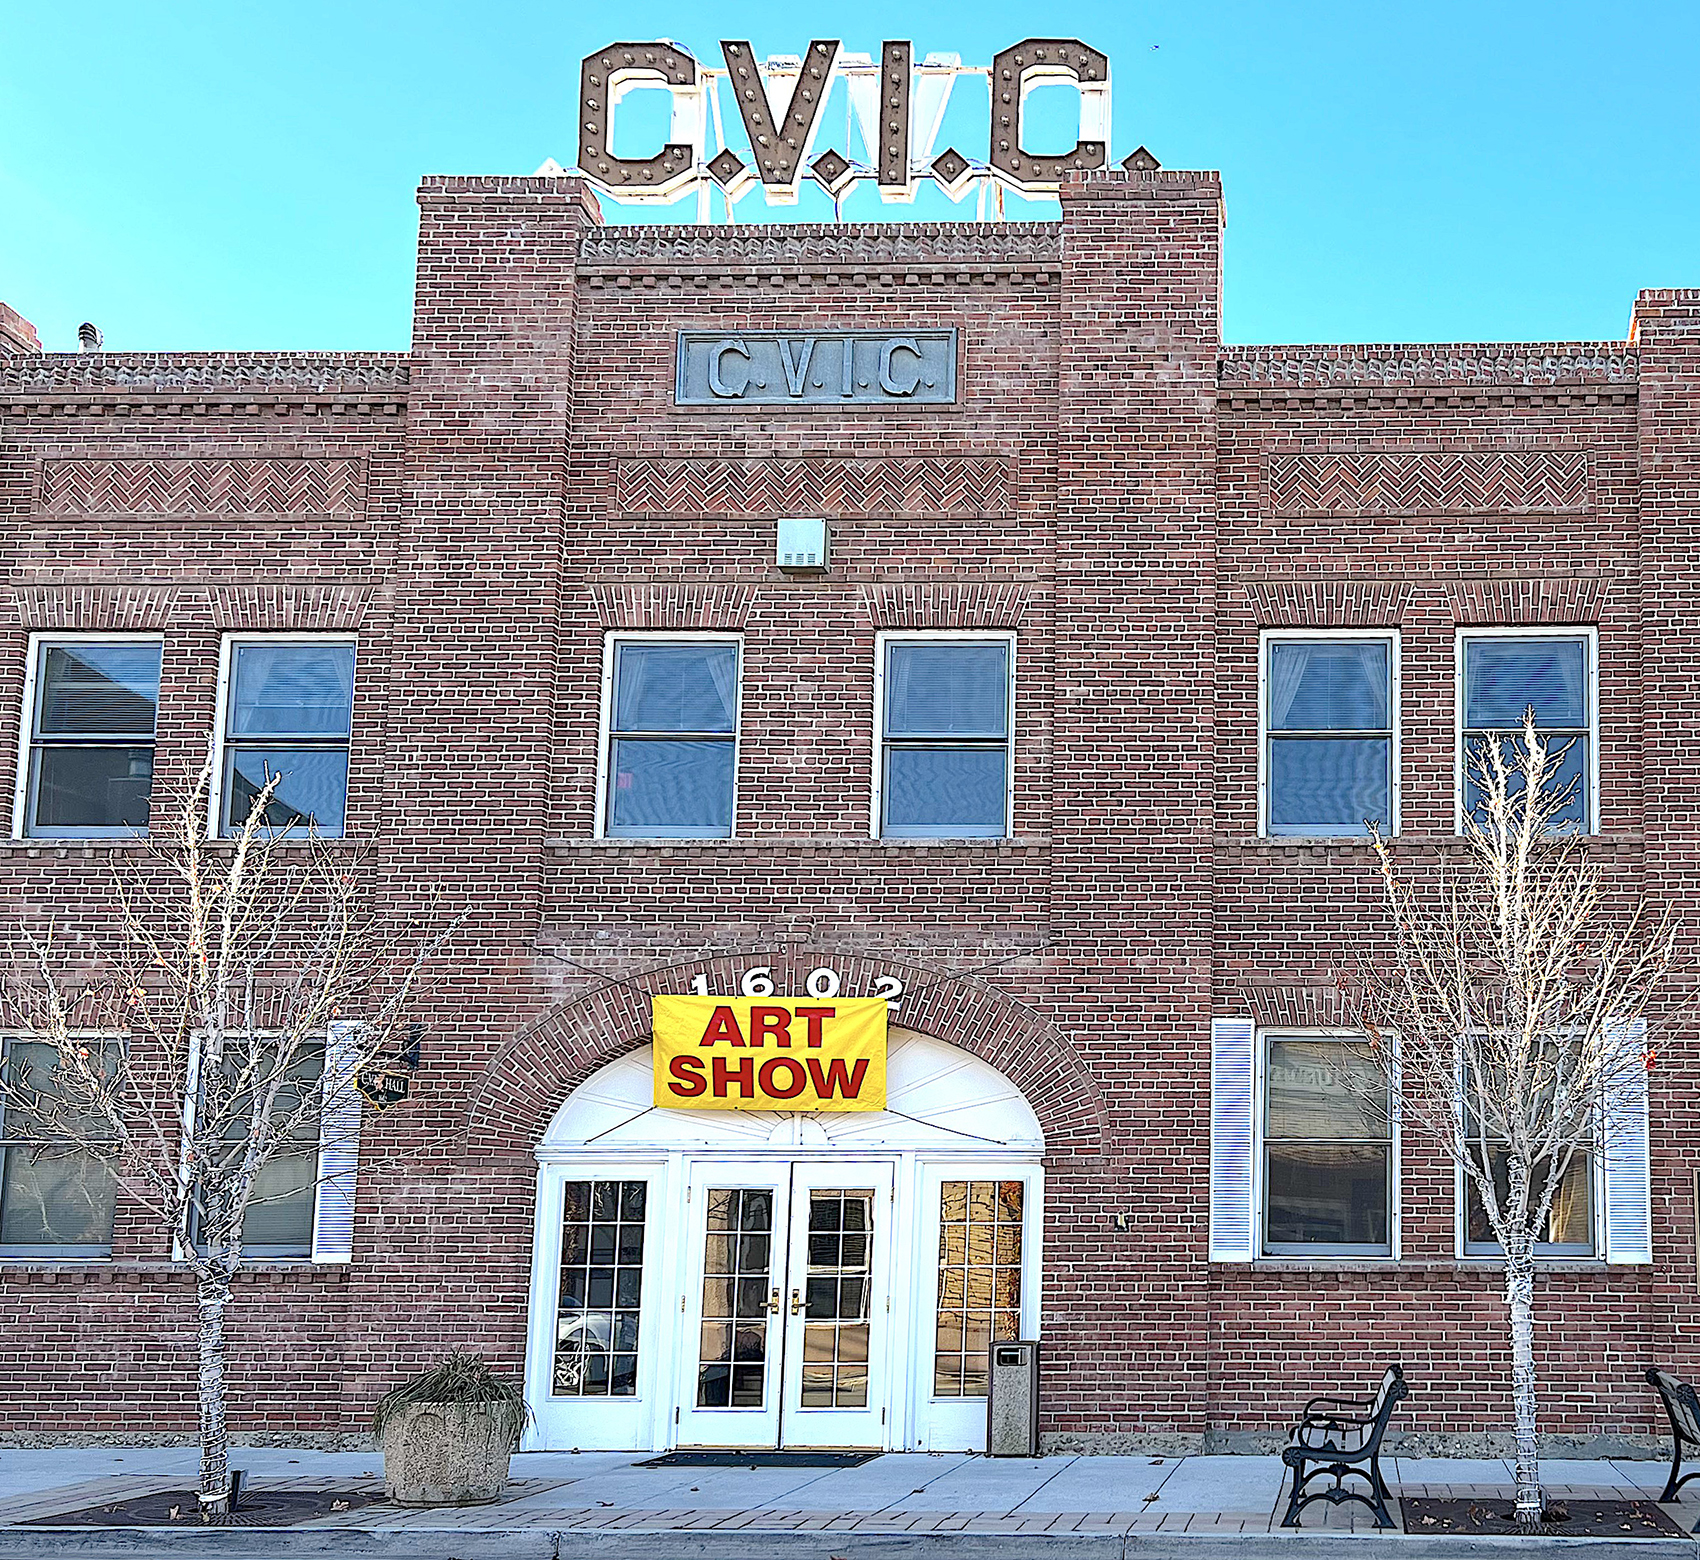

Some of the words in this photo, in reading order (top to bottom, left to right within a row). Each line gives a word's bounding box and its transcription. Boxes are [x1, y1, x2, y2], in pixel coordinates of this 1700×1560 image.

[577, 38, 1161, 192] C.V.I.C.
[708, 338, 935, 398] C.V.I.C.
[691, 966, 904, 1012] 1602
[699, 1005, 836, 1049] ART
[384, 1077, 405, 1094] HALL
[667, 1054, 870, 1100] SHOW
